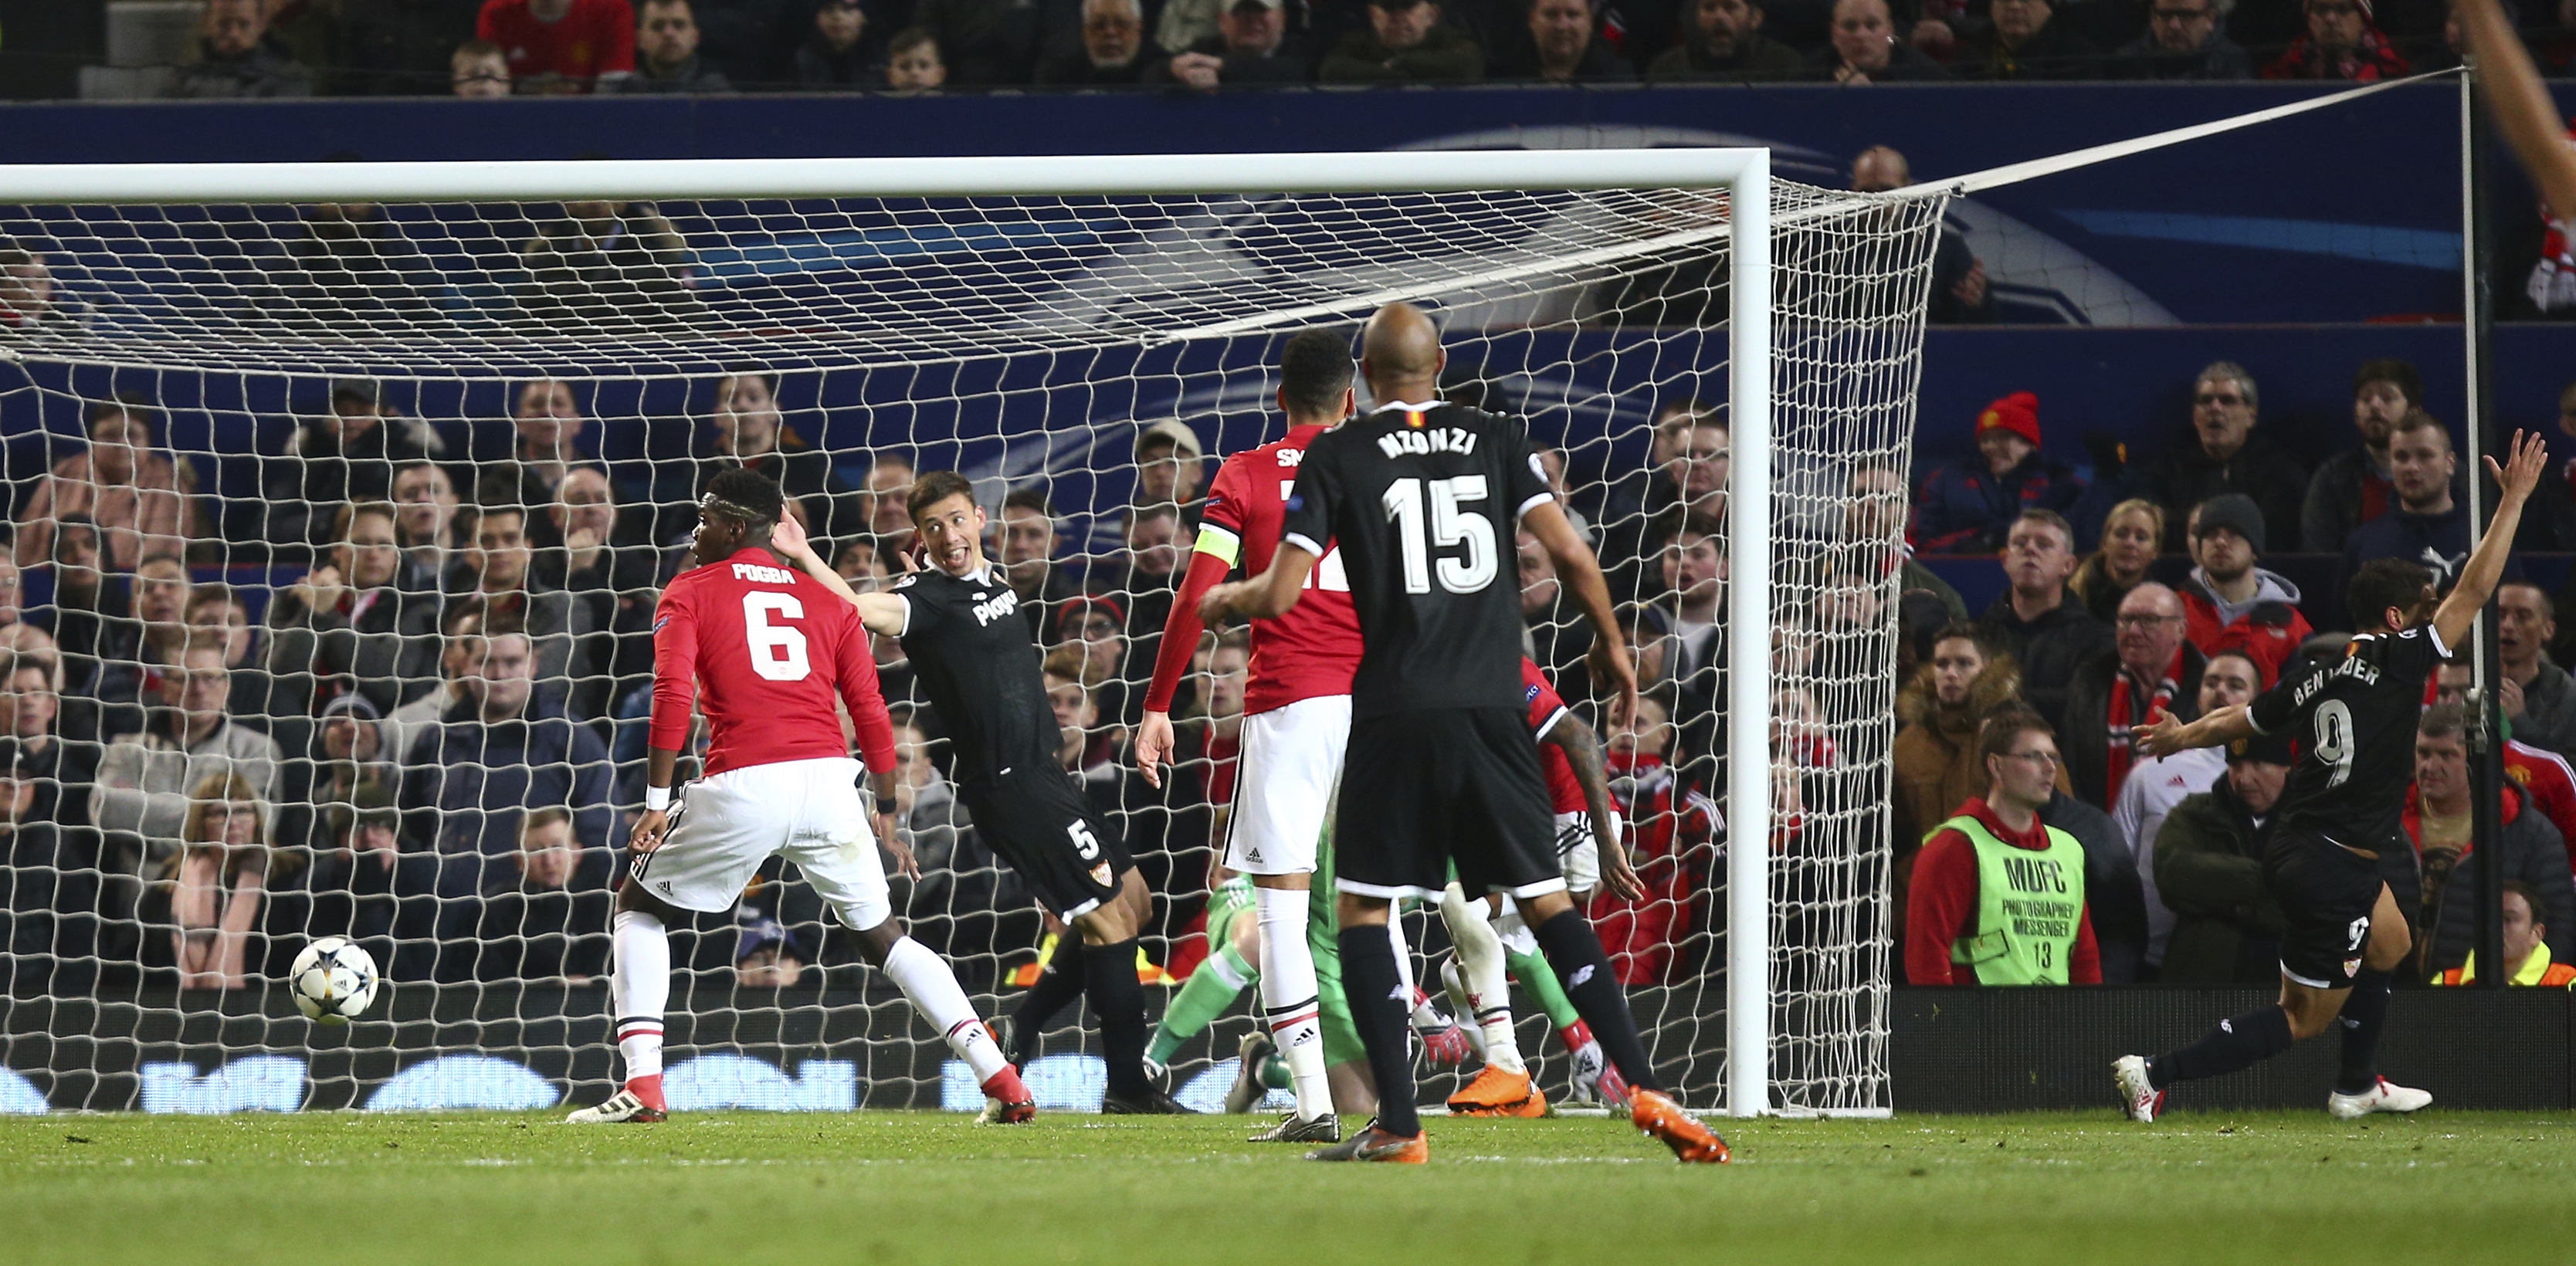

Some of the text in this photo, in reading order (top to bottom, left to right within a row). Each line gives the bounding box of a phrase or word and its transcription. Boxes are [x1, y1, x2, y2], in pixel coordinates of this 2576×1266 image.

[1378, 427, 1477, 459] NZONZI
[1381, 474, 1499, 594] 15
[731, 563, 796, 584] POGBA
[742, 590, 812, 681] 6
[2293, 669, 2323, 706] BEN
[2314, 699, 2354, 789] 9
[1066, 817, 1100, 860] 5
[2003, 857, 2067, 894] MUFC
[2013, 919, 2069, 937] MESSENGER
[2348, 916, 2369, 951] 9
[2034, 941, 2052, 969] 13
